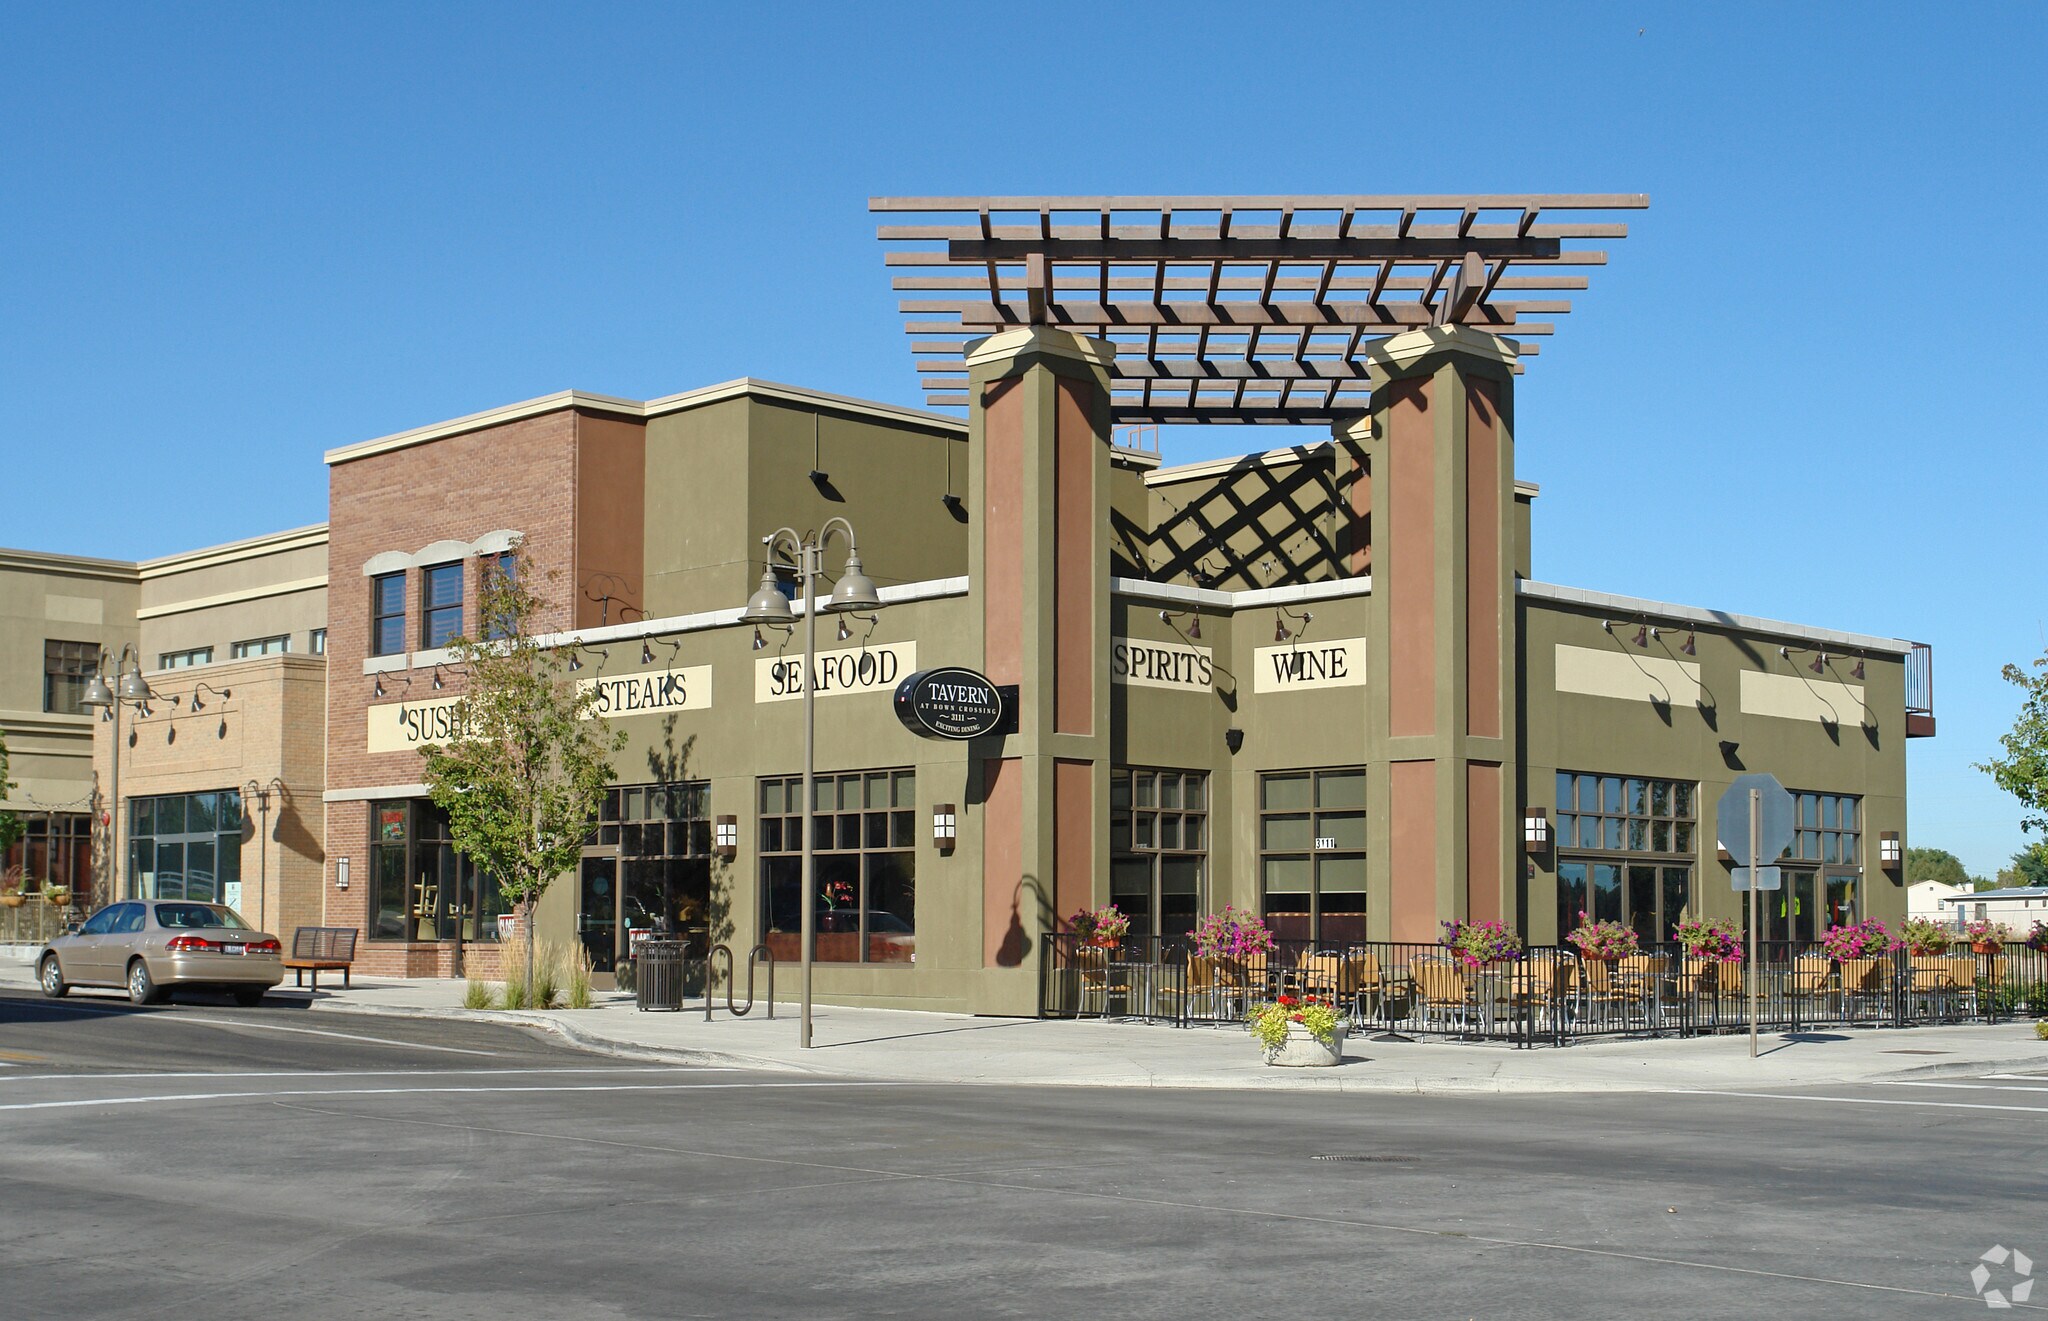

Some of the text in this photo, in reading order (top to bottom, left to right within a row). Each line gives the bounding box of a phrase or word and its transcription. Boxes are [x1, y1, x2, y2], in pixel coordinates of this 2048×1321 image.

[1114, 644, 1212, 687] SPIRITS
[1271, 647, 1349, 684] WINE
[598, 674, 687, 713] STEAKS
[928, 683, 989, 704] TAVERN
[933, 703, 954, 711] BOWN
[959, 706, 996, 714] CROSSING
[1316, 838, 1334, 849] 3111
